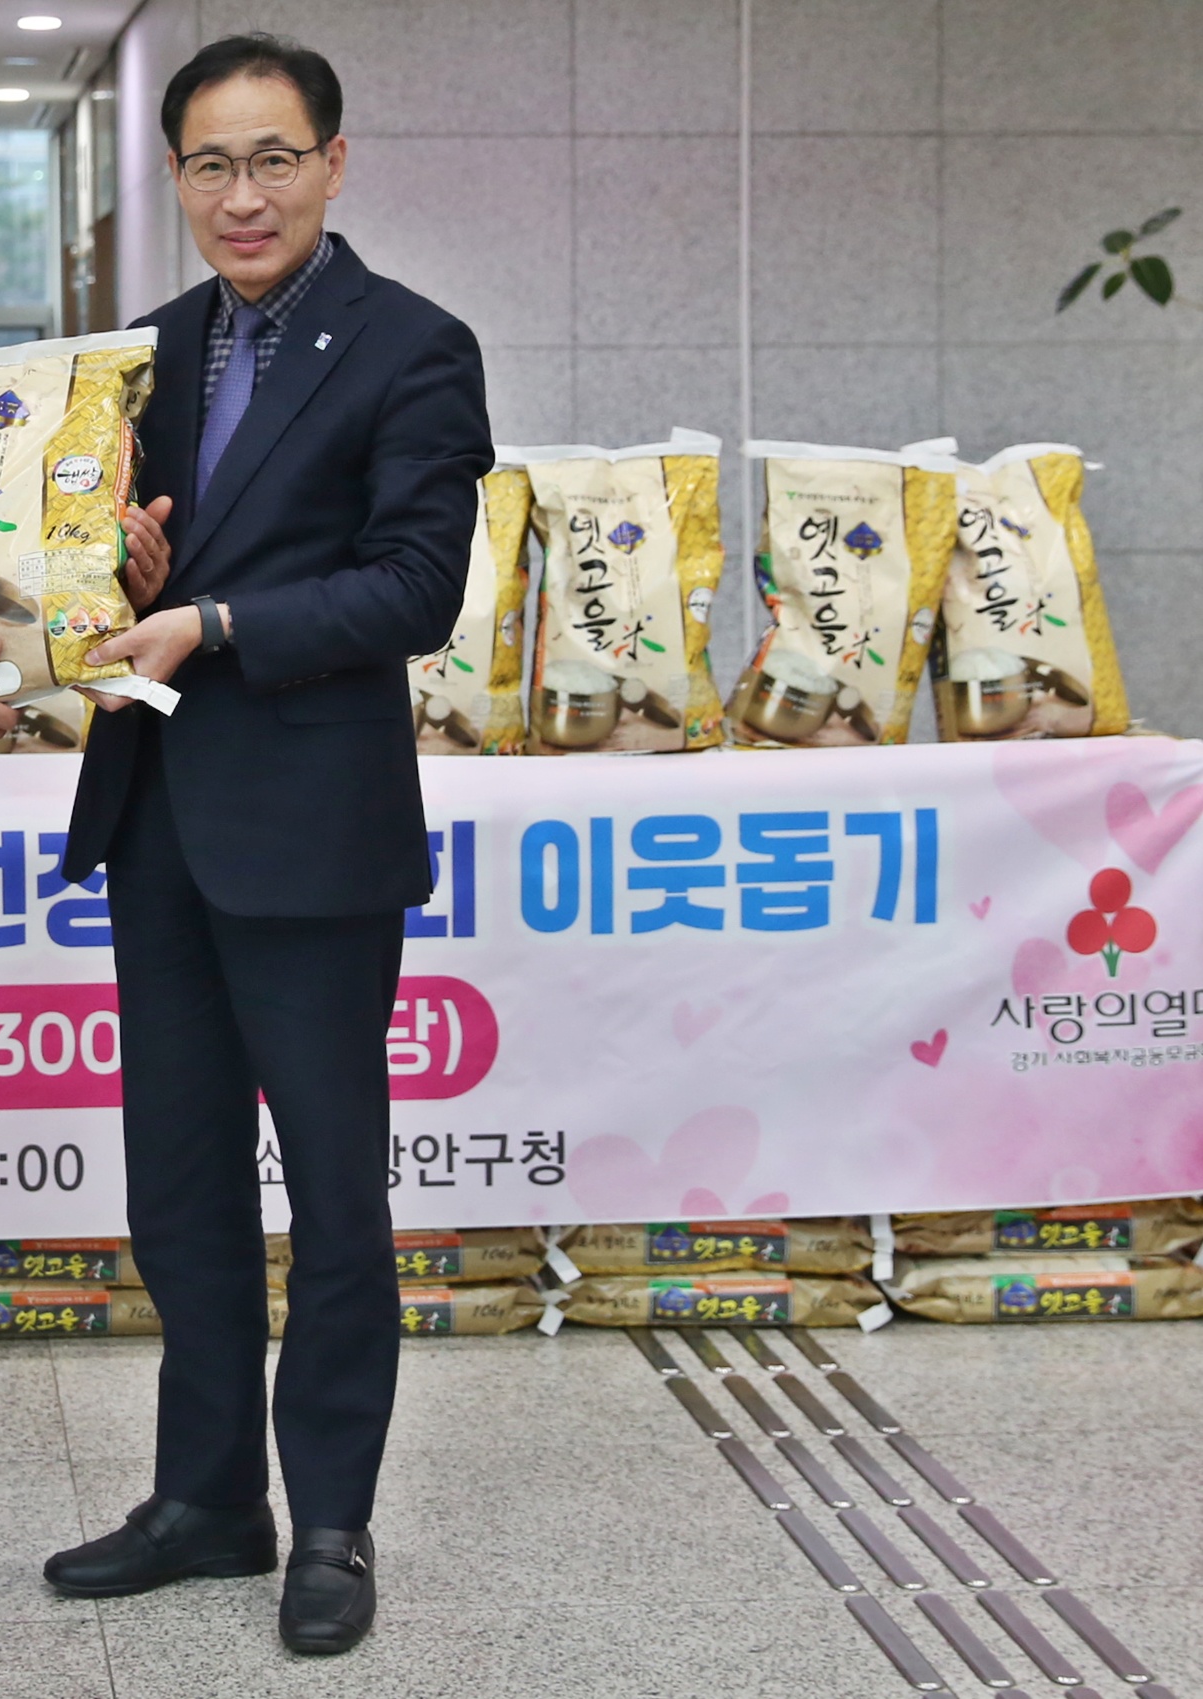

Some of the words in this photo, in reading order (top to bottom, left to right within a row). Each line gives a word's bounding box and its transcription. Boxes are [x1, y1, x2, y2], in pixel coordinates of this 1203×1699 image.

[46, 523, 91, 545] 10kg
[570, 515, 617, 652] 옛고을
[958, 508, 1019, 632] 옛고을
[799, 516, 848, 656] 옛고을
[520, 807, 939, 935] 이웃돕기
[1011, 1051, 1048, 1073] 경기
[692, 1236, 759, 1261] 옛고을
[1038, 1220, 1104, 1249] 옛고을
[22, 1252, 89, 1280] 옛고을
[696, 1295, 762, 1322] 옛고을
[1039, 1287, 1105, 1316] 옛고을
[14, 1307, 80, 1334] 옛고을
